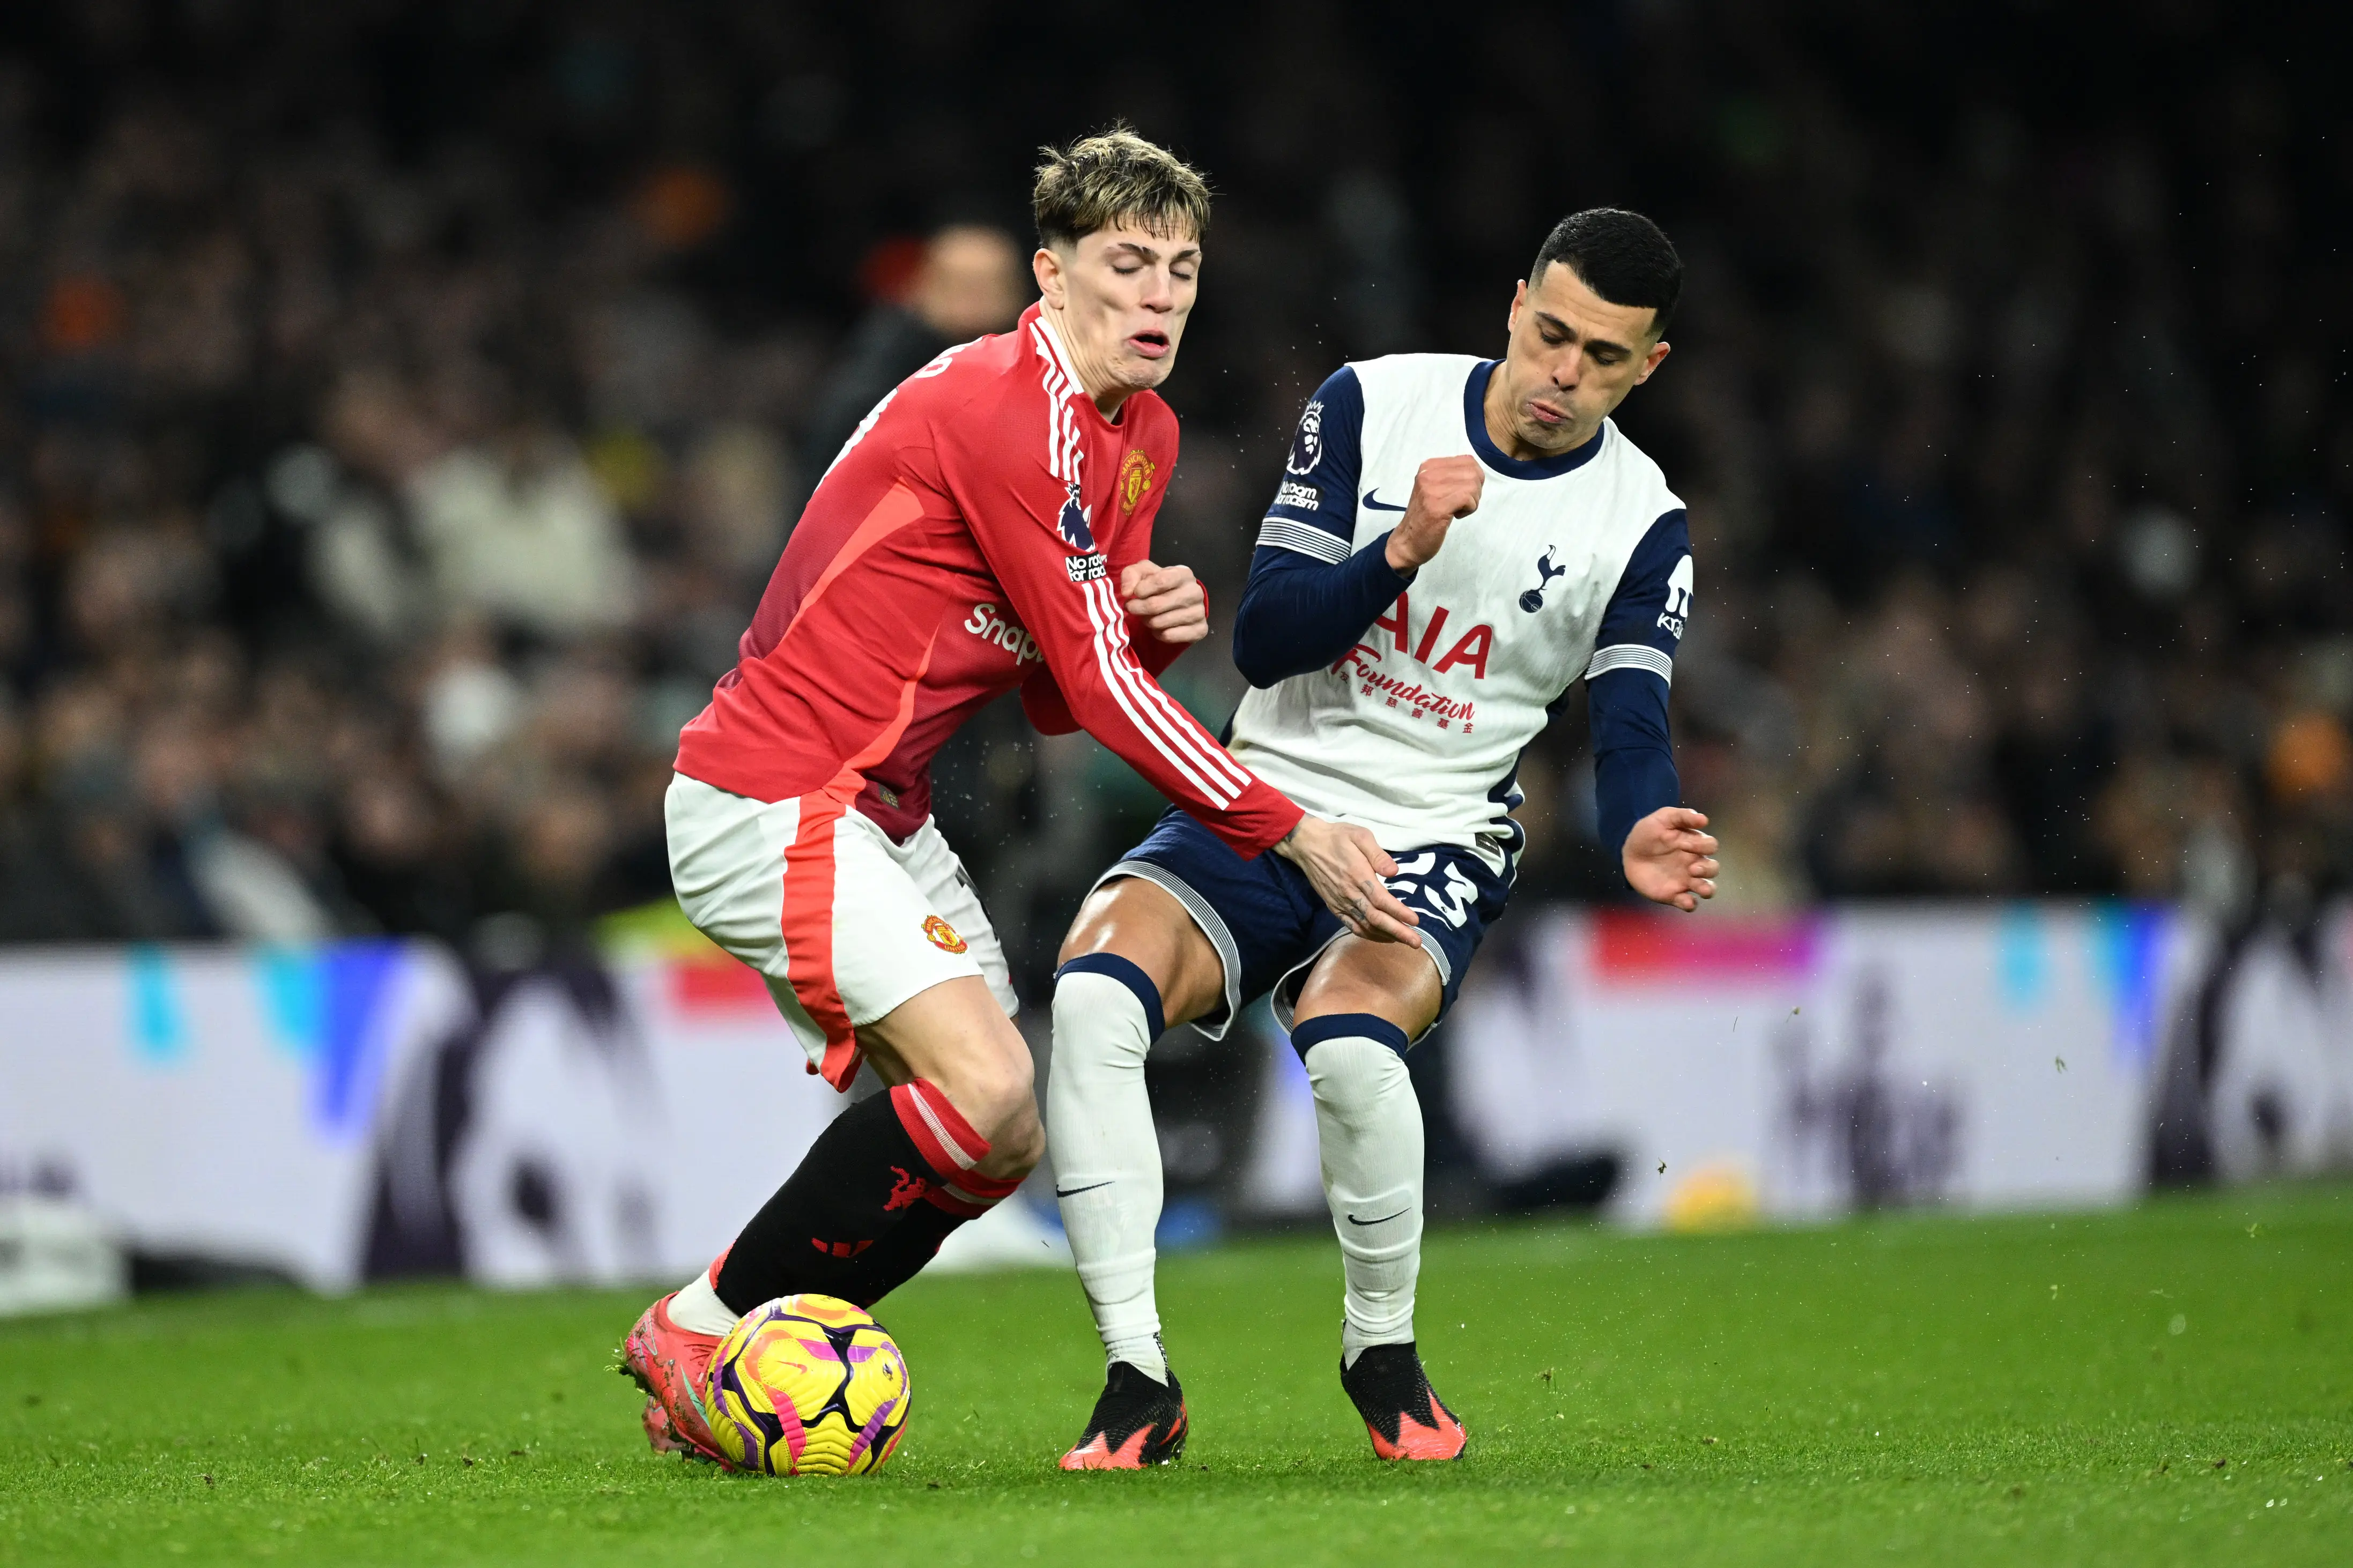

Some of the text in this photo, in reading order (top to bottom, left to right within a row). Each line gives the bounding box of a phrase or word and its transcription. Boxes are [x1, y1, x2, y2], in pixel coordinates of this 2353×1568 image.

[1065, 556, 1087, 570] No
[1068, 568, 1086, 582] for
[964, 603, 1044, 666] Snap
[1374, 591, 1492, 680] AIA
[1331, 643, 1475, 720] Foundation
